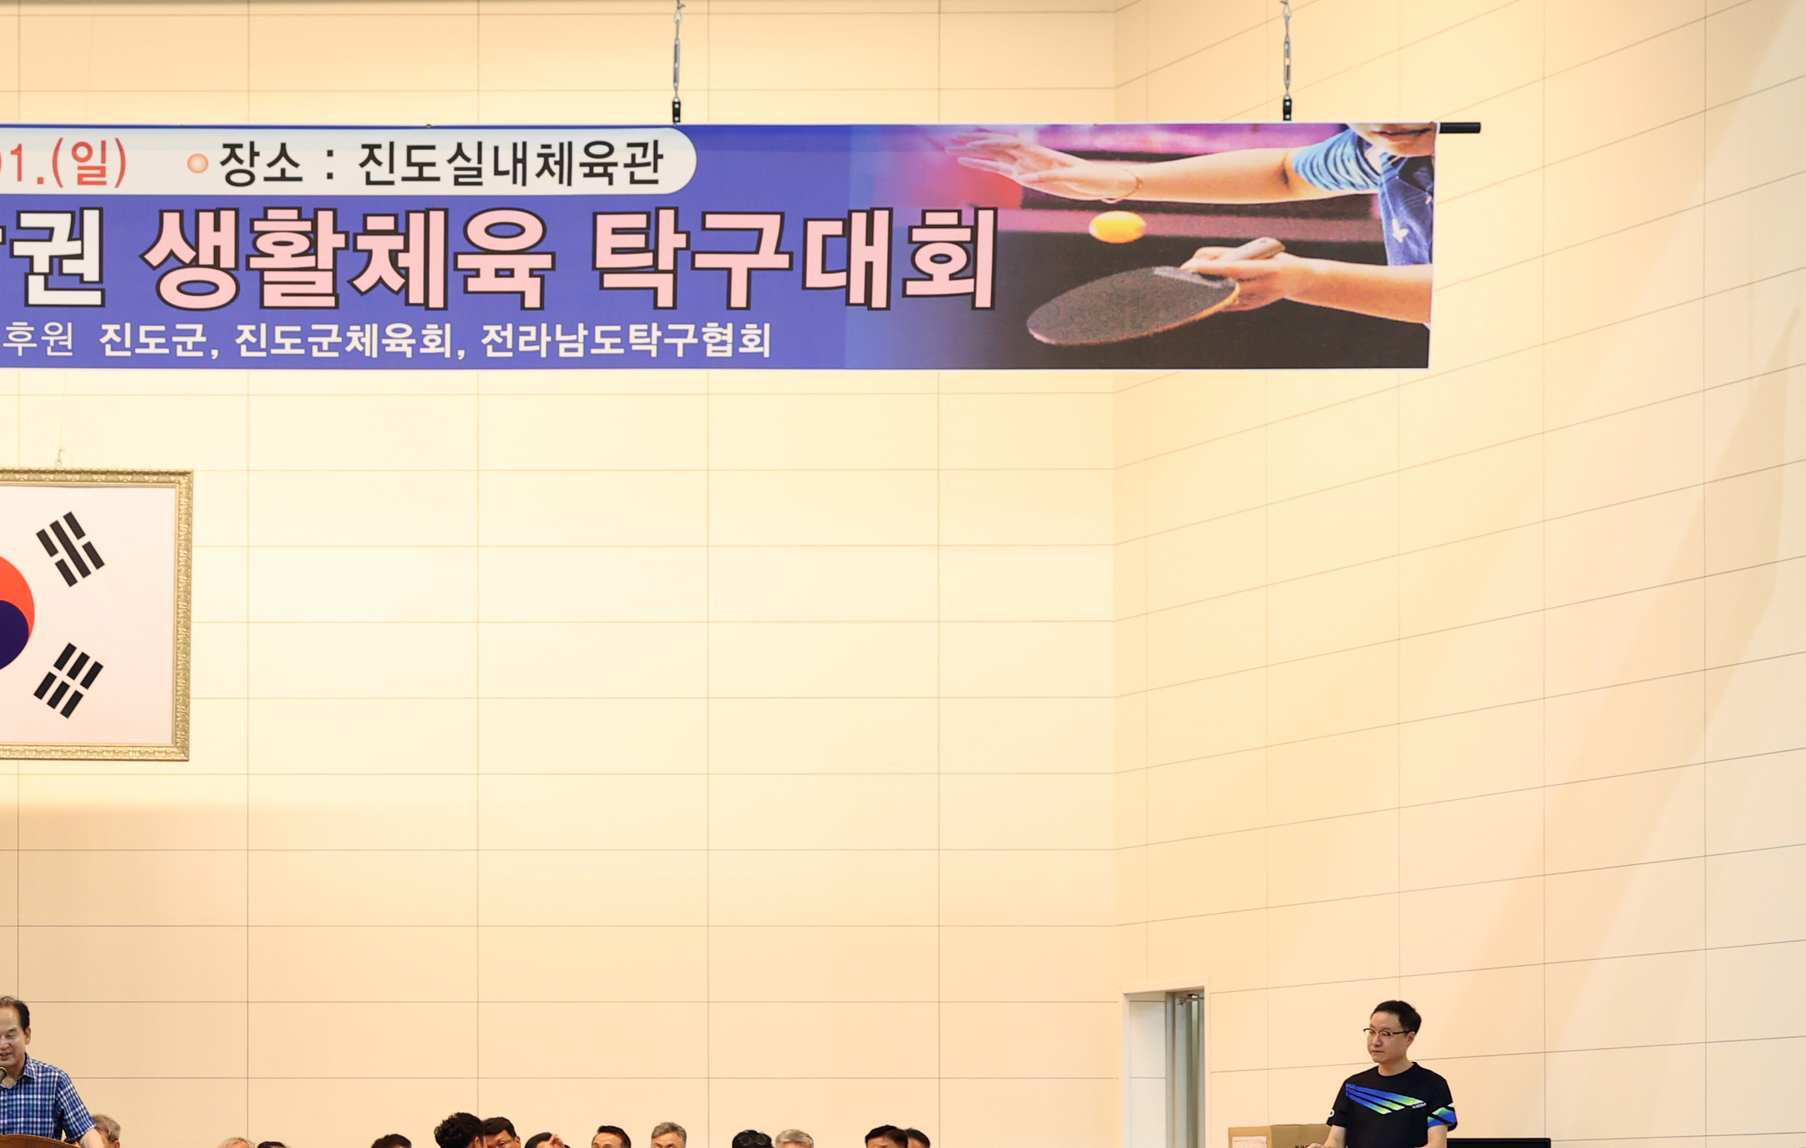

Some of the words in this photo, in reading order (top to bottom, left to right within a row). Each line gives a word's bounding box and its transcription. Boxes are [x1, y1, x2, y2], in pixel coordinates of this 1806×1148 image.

[219, 140, 304, 187] 장소
[359, 138, 665, 188] 진도실내체육관
[142, 206, 556, 311] 생활체육
[593, 206, 998, 312] 탁구대회
[2, 321, 75, 357] 후원
[98, 321, 220, 360] 진도군,
[234, 322, 466, 360] 진도군체육회,
[480, 322, 773, 358] 전라남도탁구협회
